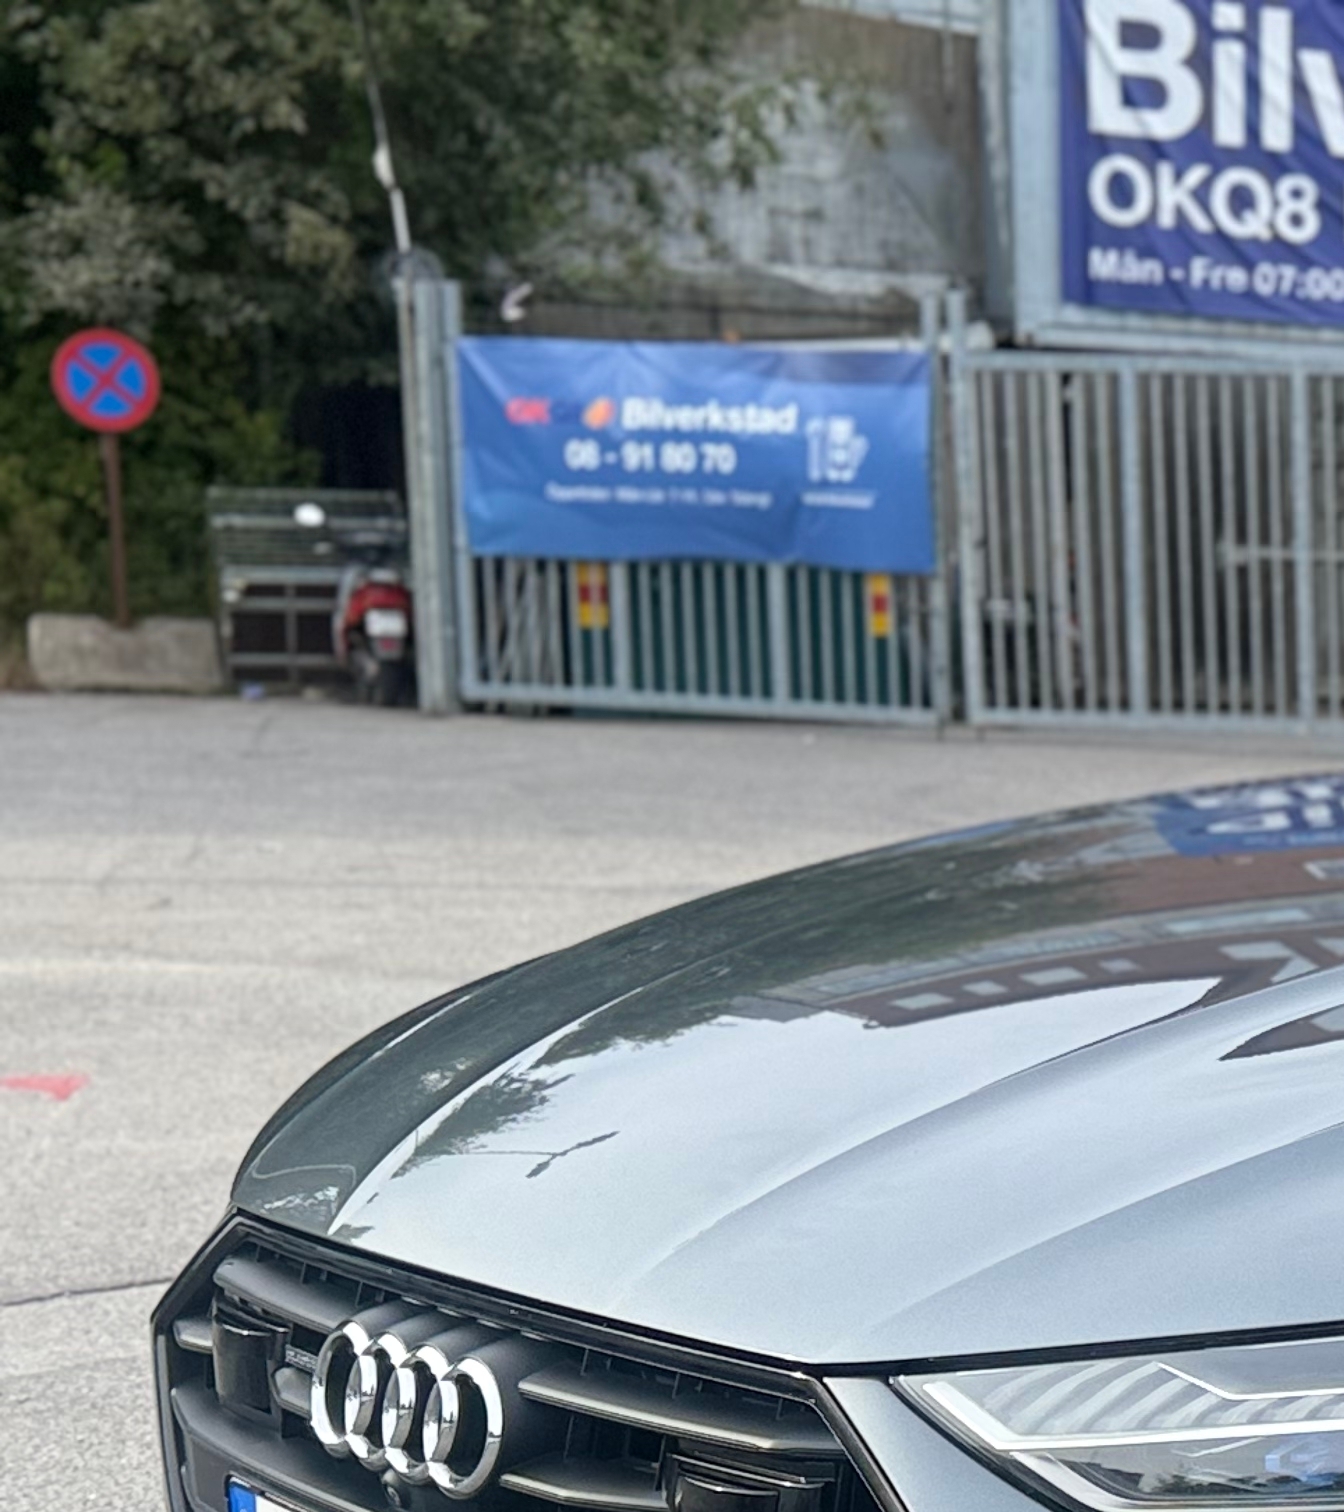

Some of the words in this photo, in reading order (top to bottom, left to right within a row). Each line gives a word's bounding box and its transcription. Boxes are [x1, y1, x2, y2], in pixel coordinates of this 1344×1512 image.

[1088, 153, 1321, 244] OKQ8
[1189, 256, 1249, 293] Fre
[620, 396, 799, 434] Bilverkstad
